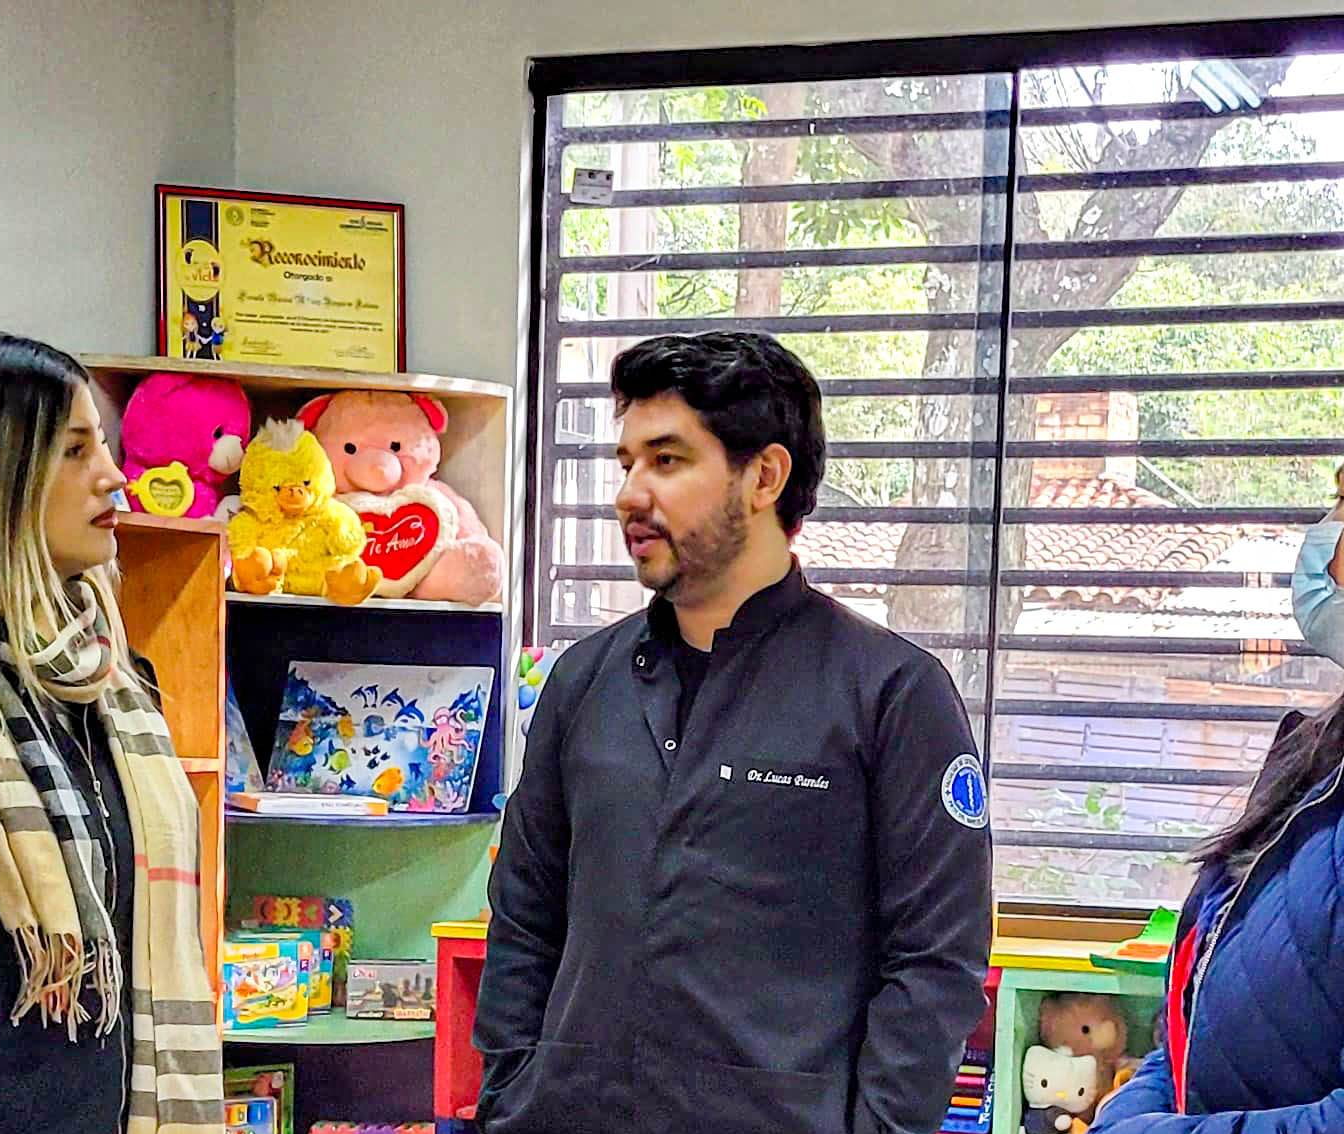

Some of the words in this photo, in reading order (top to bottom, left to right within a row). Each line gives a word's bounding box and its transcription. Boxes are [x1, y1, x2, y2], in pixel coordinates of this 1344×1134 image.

[249, 239, 367, 271] Reconocimiento
[367, 538, 382, 557] Te
[763, 771, 793, 785] Lucas
